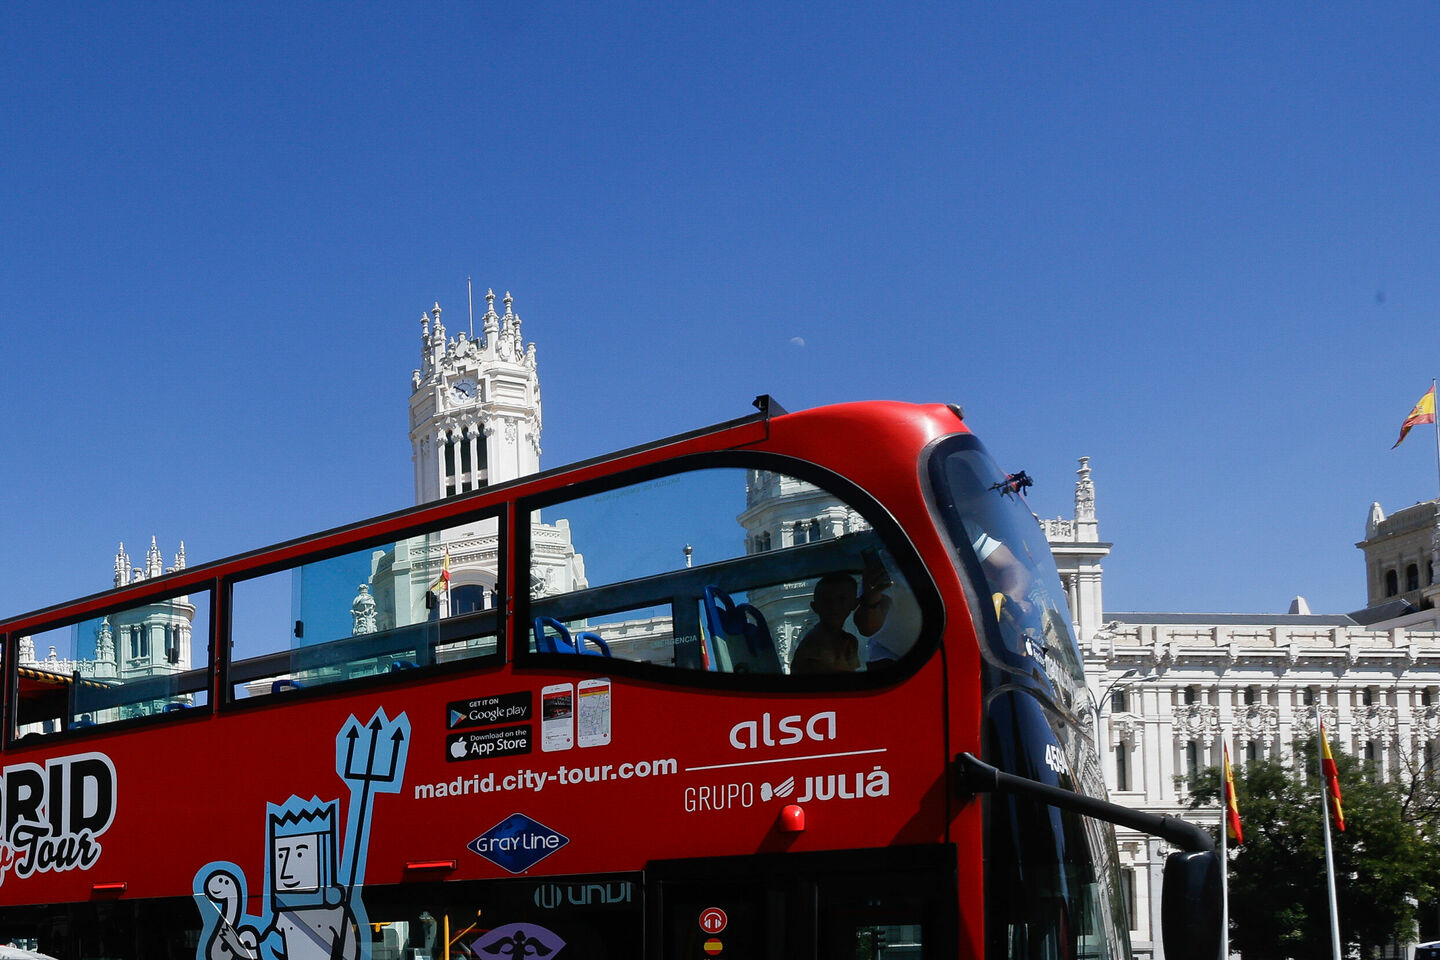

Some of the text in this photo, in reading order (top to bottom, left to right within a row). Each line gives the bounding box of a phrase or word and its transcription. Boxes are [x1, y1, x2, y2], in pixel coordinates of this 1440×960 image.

[469, 706, 527, 721] Google play
[470, 732, 504, 741] Download
[729, 711, 837, 749] alsa
[470, 738, 527, 755] App Store
[414, 758, 678, 799] madrid.city-tour.com
[684, 782, 753, 812] GRUPO
[14, 824, 101, 877] Tour
[476, 837, 521, 852] Gray
